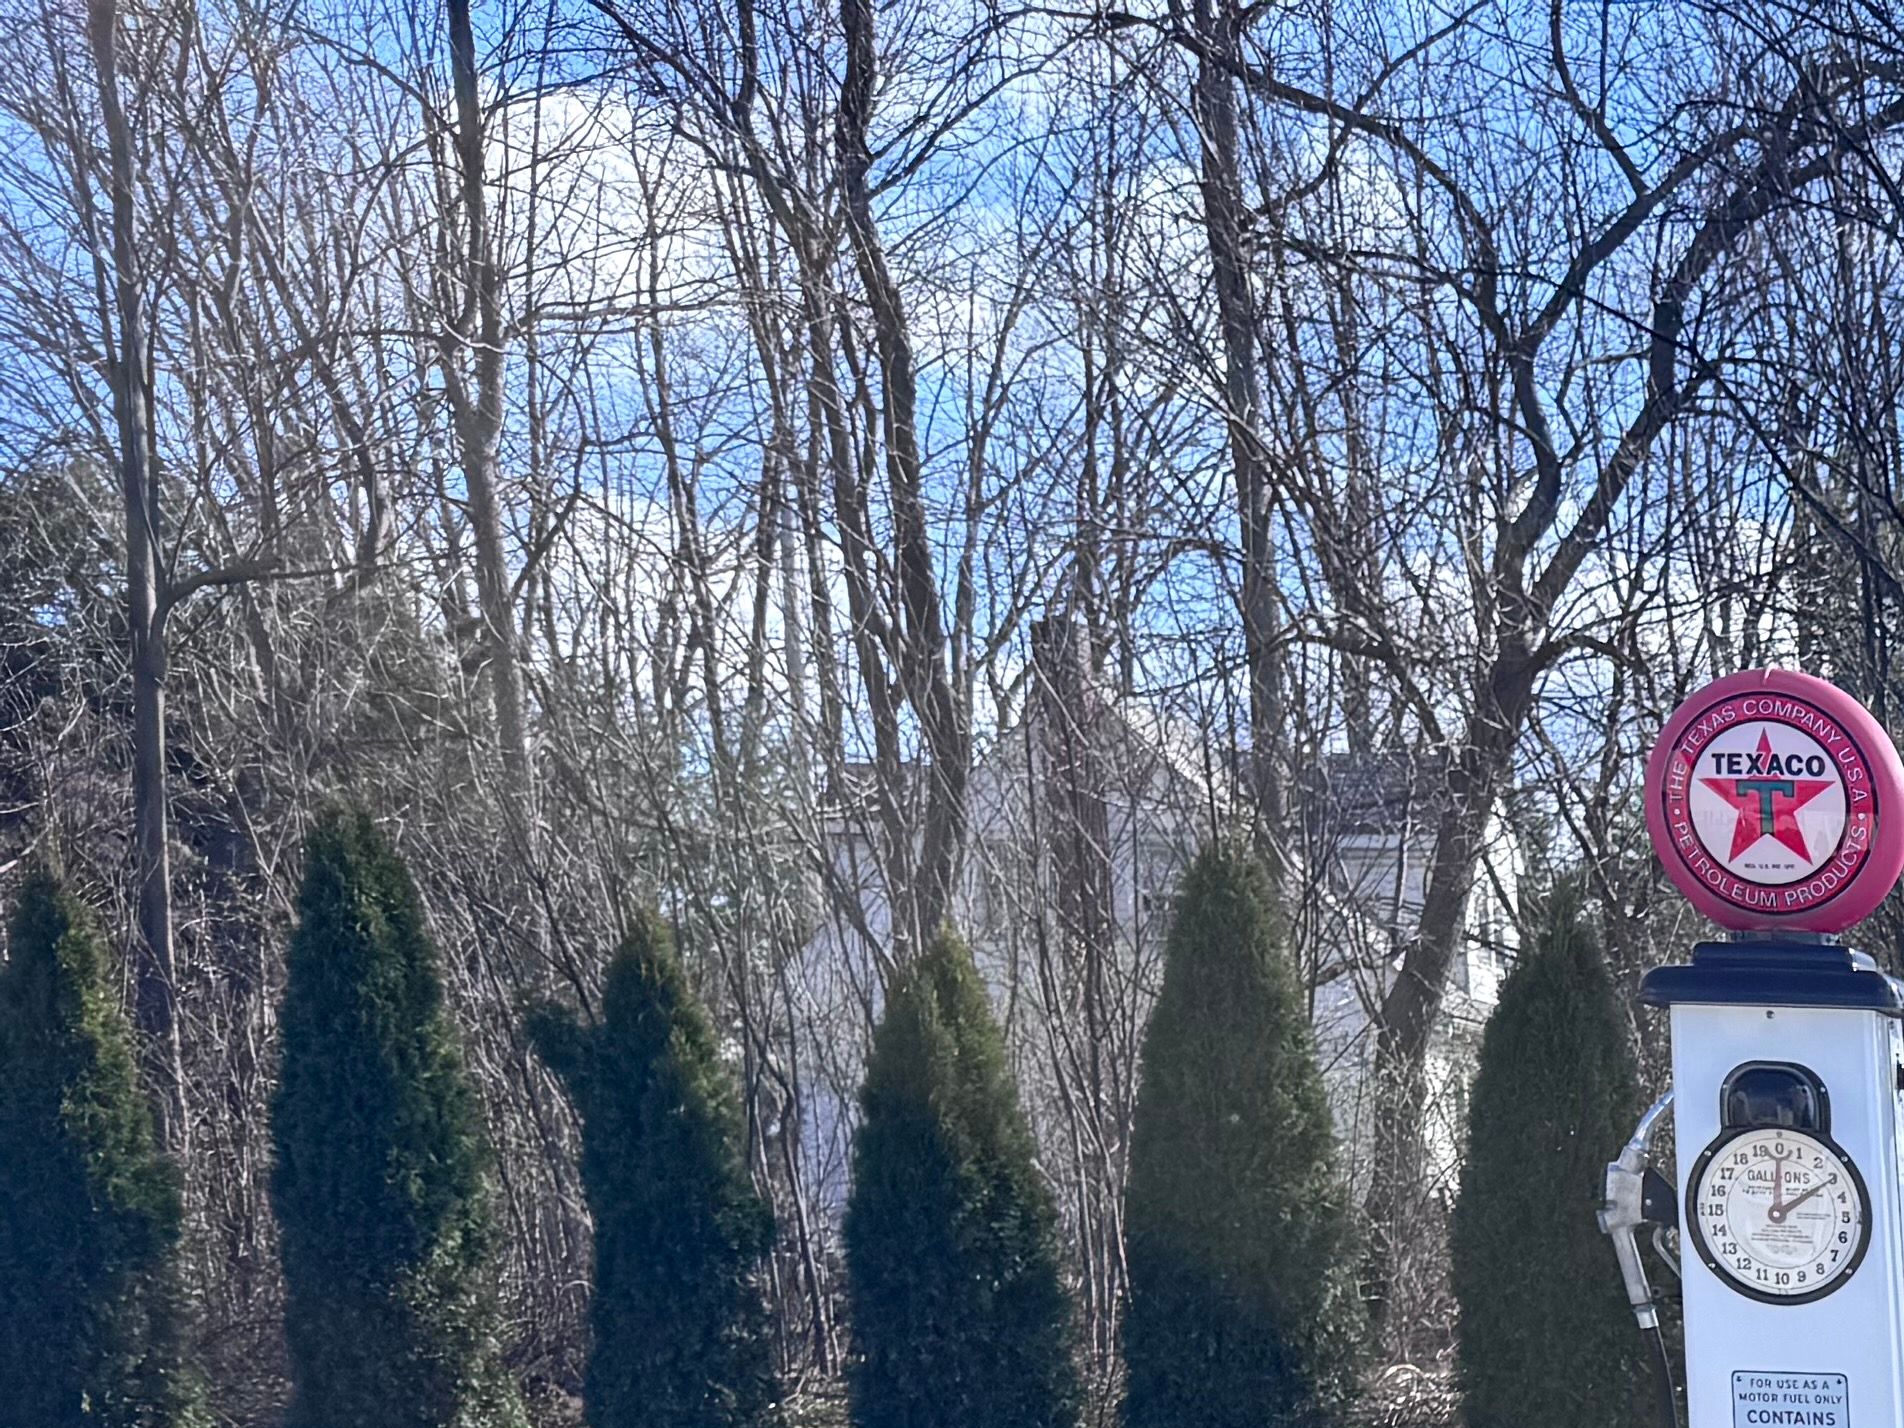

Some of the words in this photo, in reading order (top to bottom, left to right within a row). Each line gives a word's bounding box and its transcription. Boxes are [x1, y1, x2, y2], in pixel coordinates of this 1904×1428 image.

[1668, 761, 1686, 803] THE
[1682, 706, 1737, 756] TEXAS
[1743, 699, 1843, 744] COMPANY
[1711, 752, 1826, 777] TEXACO
[1674, 821, 1779, 908] PETROLEUM
[1785, 825, 1867, 907] PRODUCTS
[1775, 1142, 1784, 1155] 0
[1796, 1147, 1802, 1159] 1
[1733, 1153, 1749, 1165] 18
[1813, 1156, 1823, 1169] 2
[1720, 1167, 1735, 1180] 17
[1828, 1172, 1838, 1185] 3
[1711, 1184, 1726, 1197] 16
[1837, 1191, 1847, 1203] 4
[1708, 1204, 1724, 1216] 15
[1841, 1211, 1851, 1224] 5
[1712, 1224, 1727, 1236] 14
[1838, 1231, 1848, 1244] 6
[1722, 1242, 1738, 1254] 13
[1830, 1249, 1839, 1262] 7
[1736, 1258, 1752, 1270] 12
[1816, 1262, 1825, 1275] 8
[1756, 1268, 1769, 1281] 11
[1775, 1272, 1790, 1285] 10
[1797, 1270, 1807, 1282] 9
[1750, 1378, 1771, 1389] FOR
[1776, 1379, 1799, 1390] USE
[1803, 1380, 1817, 1390] AS
[1822, 1380, 1830, 1390] A
[1739, 1393, 1778, 1403] MOTOR
[1783, 1394, 1810, 1404] FUEL
[1814, 1395, 1843, 1405] ONLY
[1747, 1409, 1836, 1426] CONTAINS
